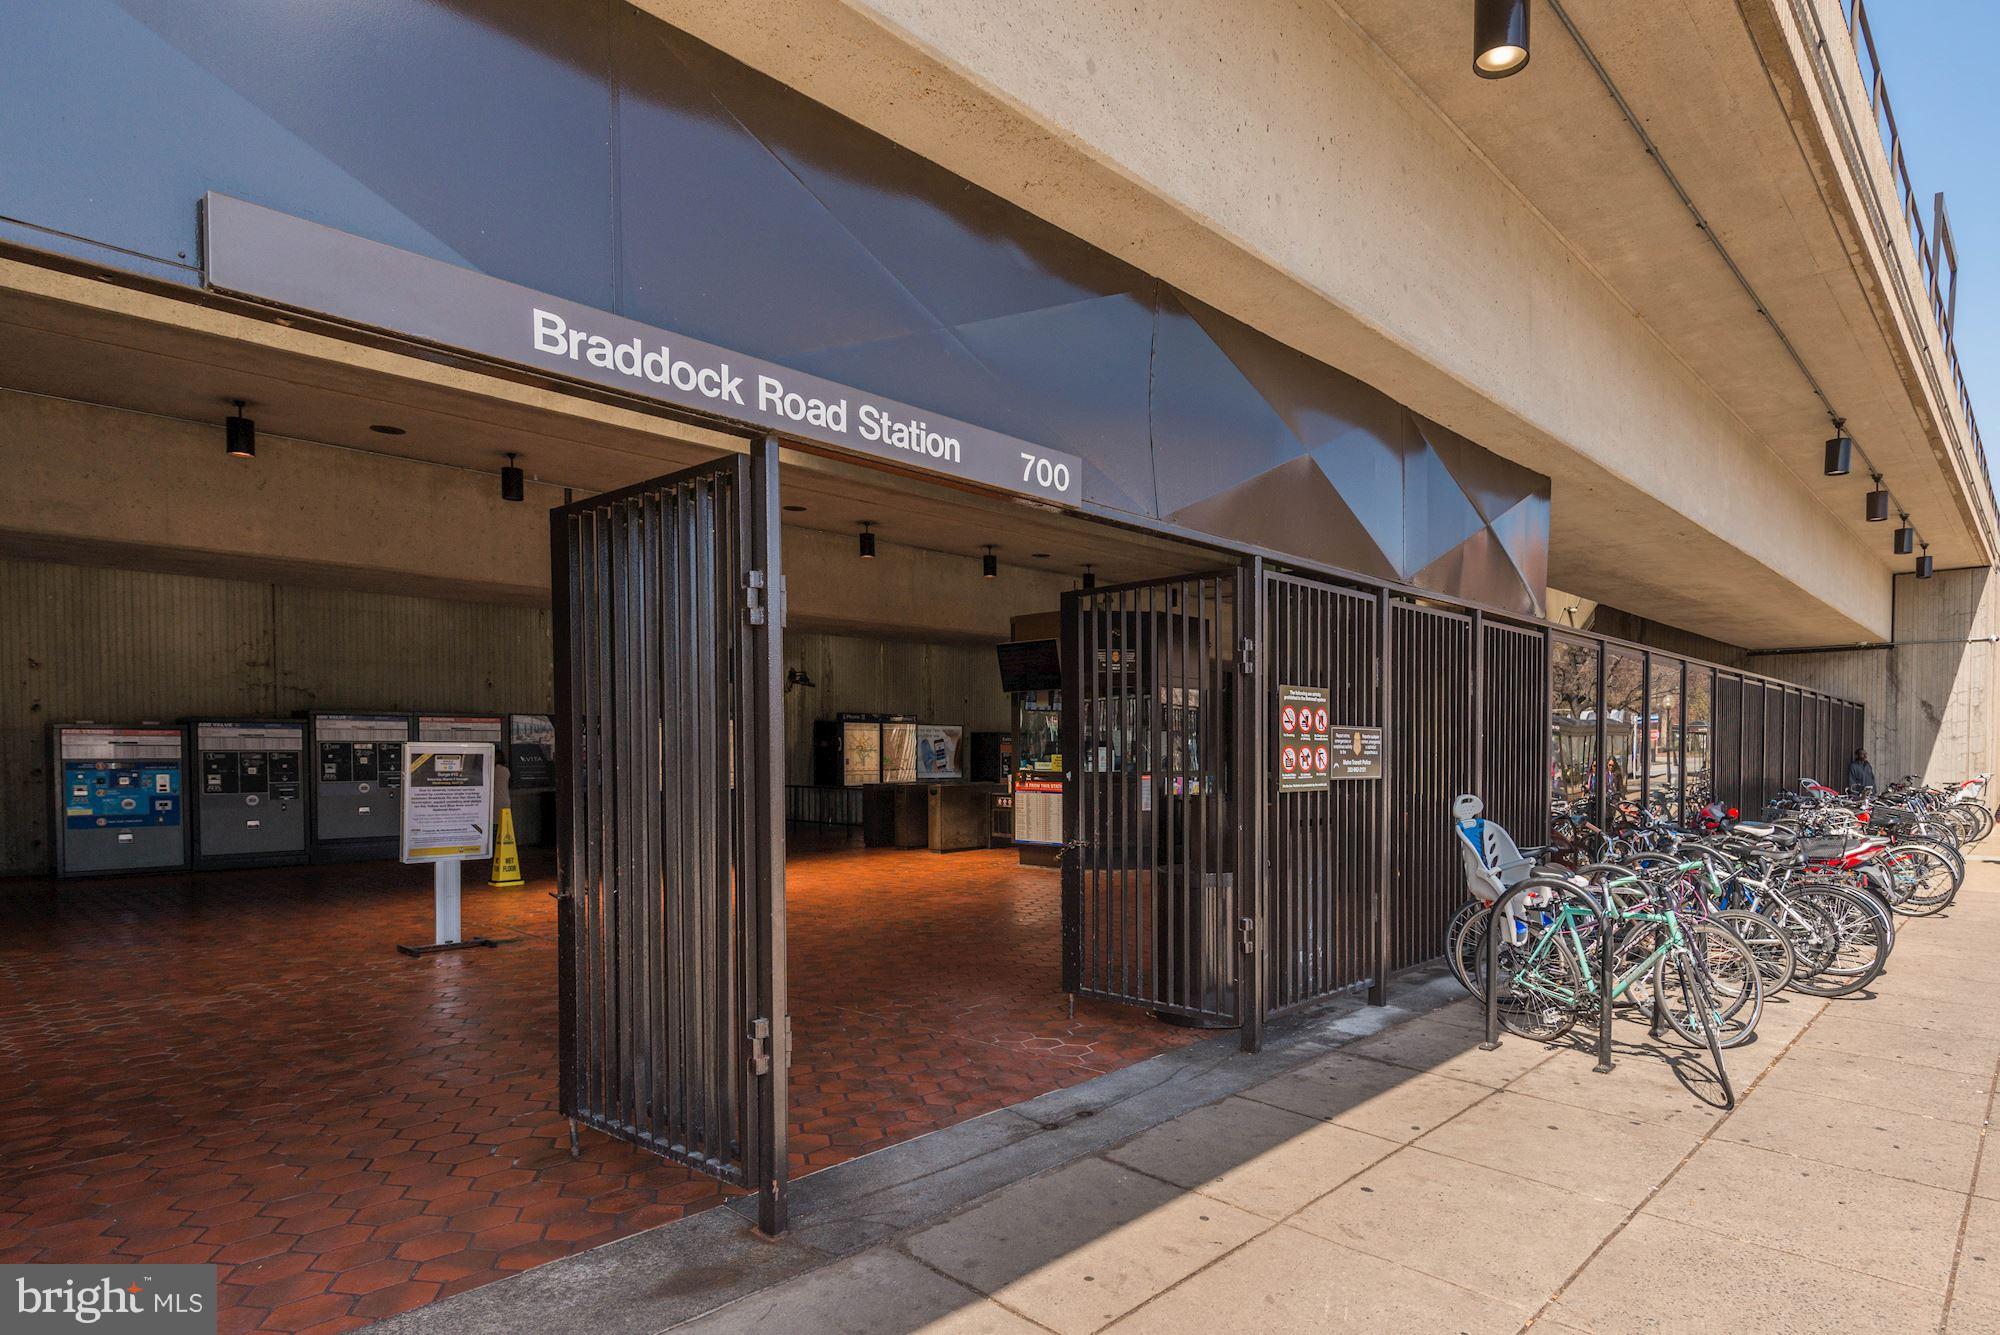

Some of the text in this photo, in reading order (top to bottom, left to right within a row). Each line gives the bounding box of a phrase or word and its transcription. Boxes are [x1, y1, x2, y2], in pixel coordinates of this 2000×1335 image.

[533, 307, 1071, 493] Braddock Road Station 700
